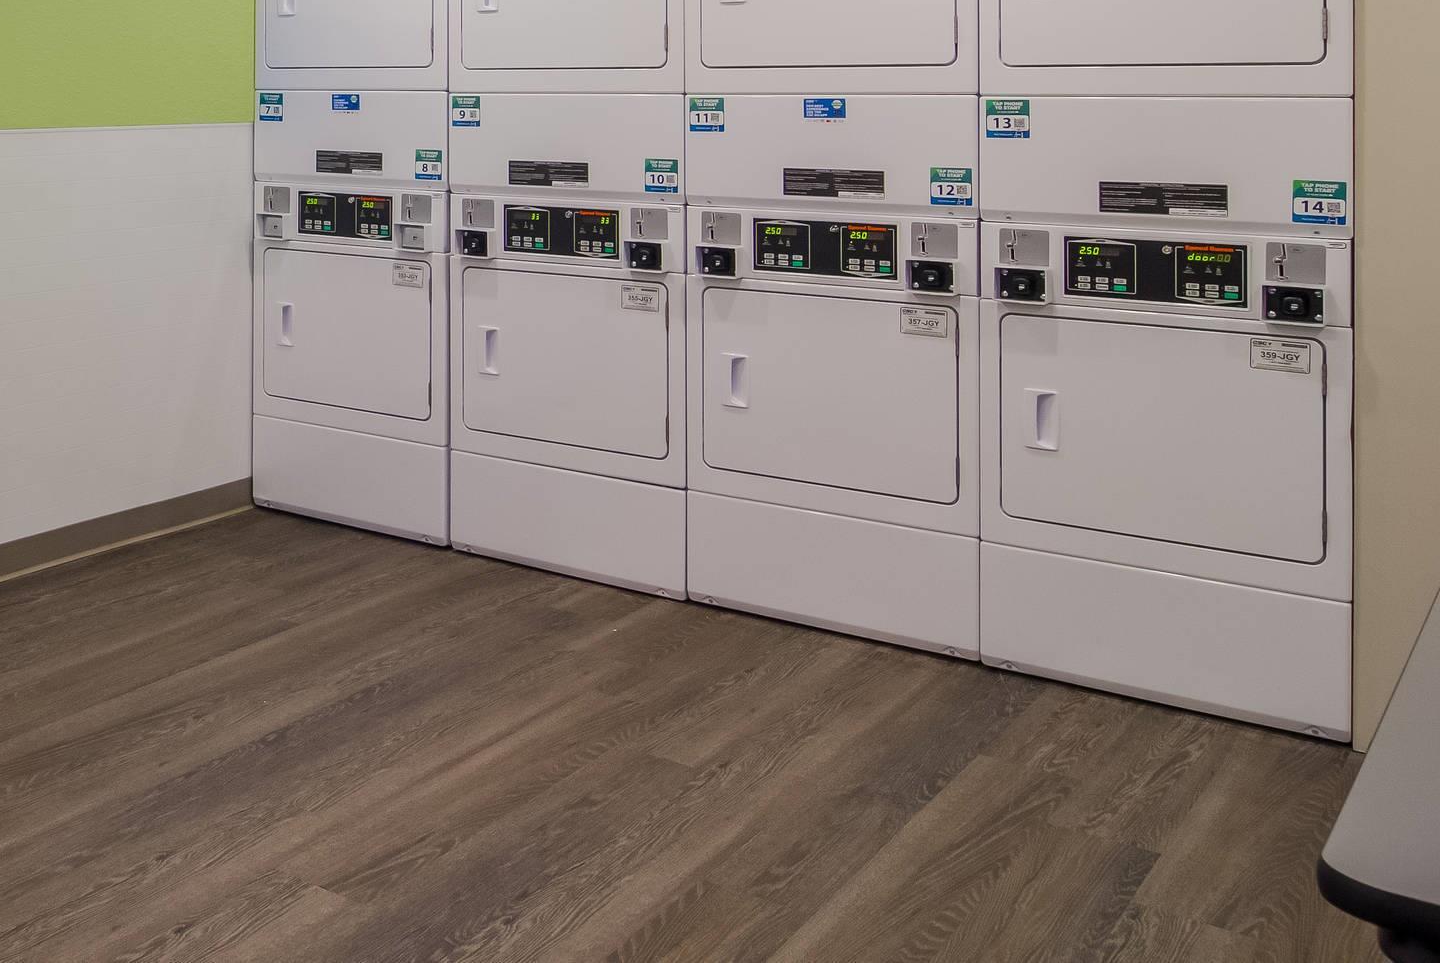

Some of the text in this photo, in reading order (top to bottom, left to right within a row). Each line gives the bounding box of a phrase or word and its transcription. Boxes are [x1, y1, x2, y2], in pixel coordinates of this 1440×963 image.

[265, 106, 271, 115] 7
[459, 110, 466, 119] 9
[695, 113, 708, 123] 11
[993, 117, 1012, 129] 13
[421, 163, 428, 172] 8
[649, 174, 665, 184] 10
[937, 185, 955, 196] 12
[1301, 200, 1324, 213] 14
[850, 231, 868, 239] 2.50
[1079, 246, 1100, 255] 2.50
[1260, 351, 1301, 361] 359-JGY
